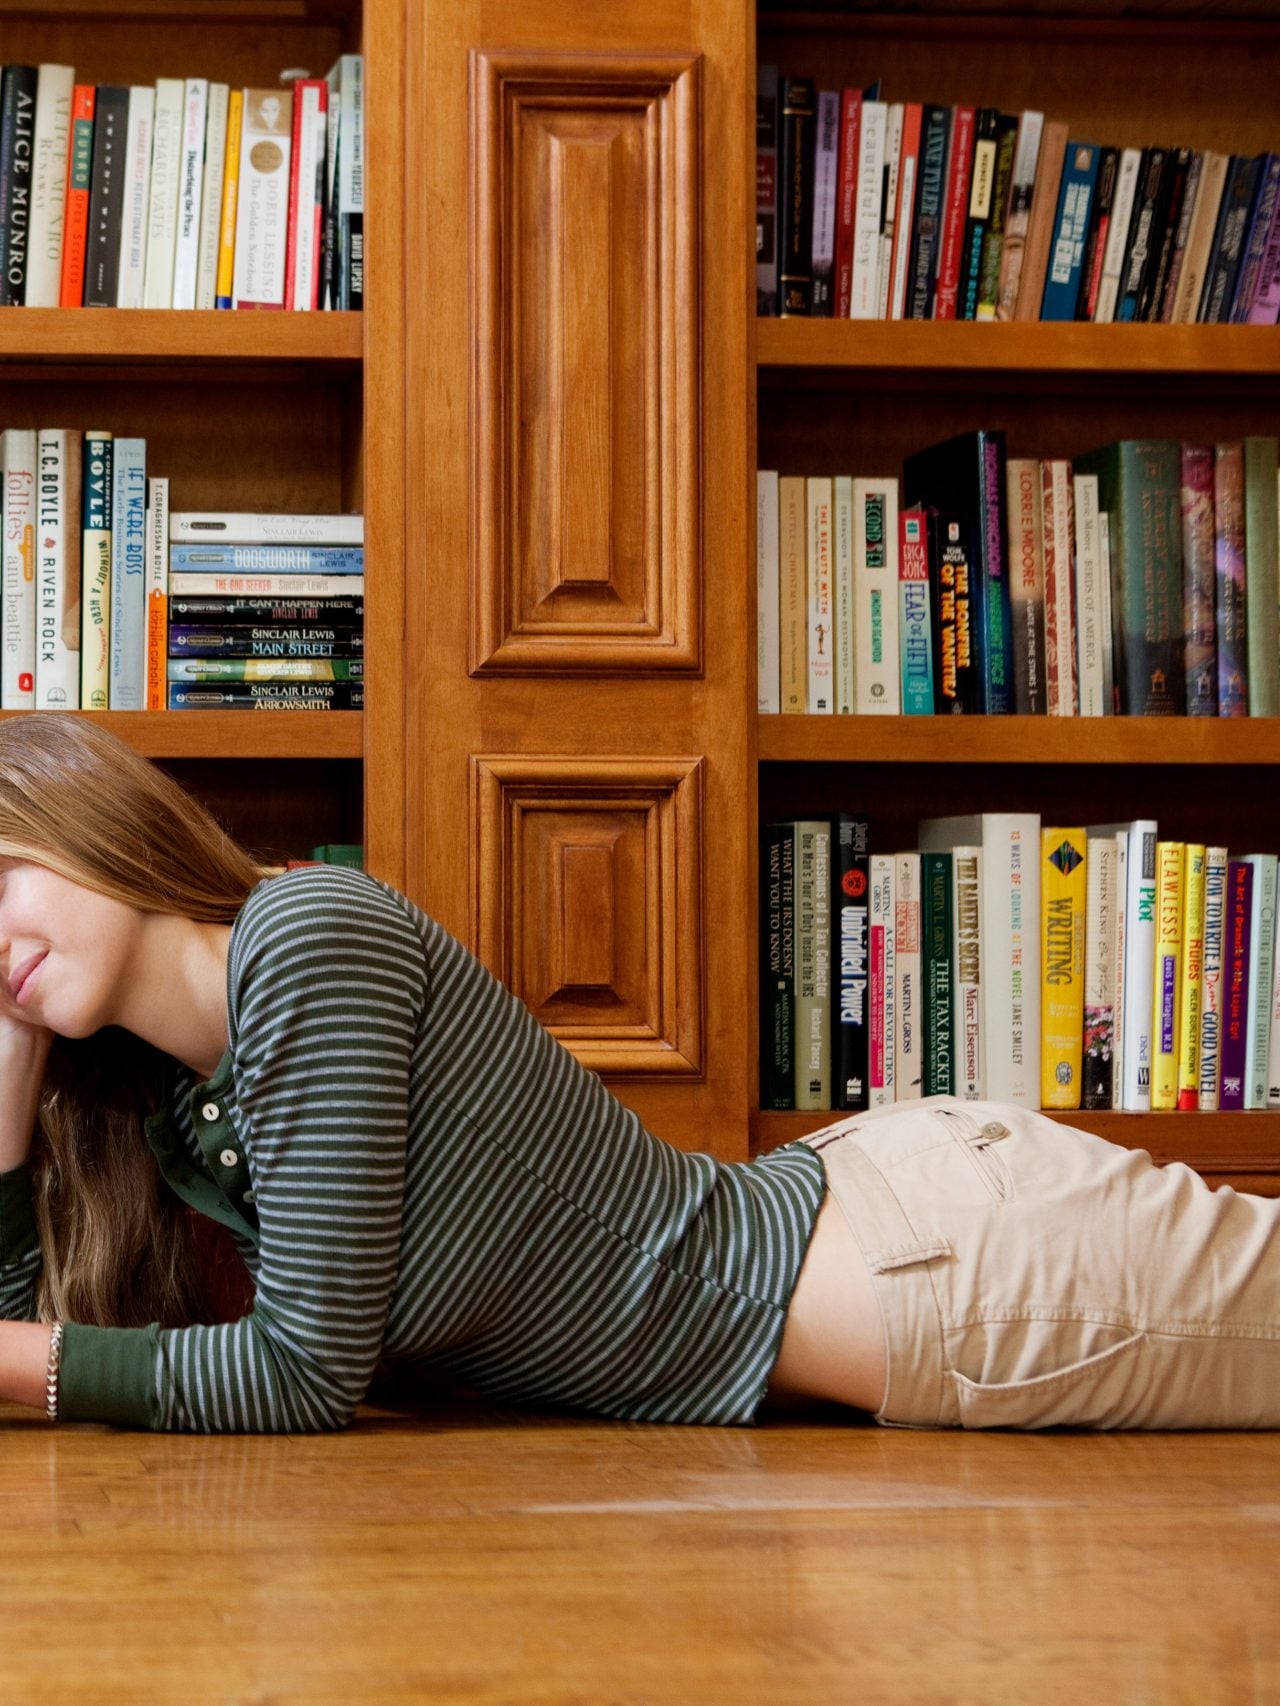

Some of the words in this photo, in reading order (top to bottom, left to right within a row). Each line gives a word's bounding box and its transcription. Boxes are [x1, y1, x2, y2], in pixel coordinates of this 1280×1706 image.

[14, 91, 32, 173] ALICE
[53, 95, 68, 164] ALICE
[35, 139, 53, 209] RUNAWAY
[76, 128, 89, 182] MUNRO
[862, 114, 882, 218] beautiful
[265, 179, 278, 226] DORIS
[351, 165, 361, 205] YOURSELF
[8, 186, 28, 285] MUNRO
[47, 179, 65, 261] MUNRO
[351, 233, 362, 258] DAVID
[858, 229, 878, 267] boy
[263, 233, 276, 299] LESSING
[351, 263, 362, 293] LIPSKY
[90, 442, 103, 528] BOYLE
[128, 467, 143, 482] IF
[7, 470, 33, 540] follies
[127, 498, 142, 537] WERE
[1020, 471, 1032, 526] LORRIE
[866, 495, 881, 542] SECOND
[126, 544, 142, 575] BOSS
[235, 550, 310, 568] DODSWORTH
[867, 545, 882, 567] SEX
[903, 543, 924, 557] ERICA
[1021, 529, 1034, 587] MOORE
[7, 555, 20, 589] ann
[42, 558, 55, 608] RIVEN
[903, 562, 924, 578] JONG
[941, 564, 953, 586] OF
[956, 564, 968, 594] THE
[1084, 560, 1094, 593] BIRDS
[6, 593, 23, 652] beattie
[905, 584, 925, 622] FEAR
[942, 591, 953, 622] THE
[1085, 597, 1094, 613] OF
[42, 618, 55, 661] ROCK
[150, 610, 163, 647] tortilla
[252, 629, 299, 640] SINCLAIR
[303, 629, 335, 639] LEWIS
[911, 625, 921, 635] OF
[957, 600, 969, 667] BONFIRE
[1085, 617, 1095, 669] AMERICA
[150, 650, 161, 688] curtain
[253, 643, 283, 653] MAIN
[289, 644, 334, 656] STREET
[907, 638, 928, 678] FIFTY
[942, 624, 956, 698] VANITIES
[251, 687, 297, 697] SINCLAIR
[301, 687, 334, 696] LEWIS
[254, 699, 330, 710] ARROWSMITH
[958, 857, 977, 879] THE
[958, 883, 979, 939] BANKER'S
[1138, 887, 1155, 922] Plot
[1163, 850, 1179, 944] FLAWLESS!
[841, 906, 866, 975] Unbridled
[1047, 897, 1073, 984] WRITING
[937, 959, 949, 995] THE
[959, 942, 979, 985] SECRET
[841, 980, 864, 1025] Power
[937, 1000, 949, 1026] TAX
[966, 988, 977, 1020] Marc
[812, 1008, 822, 1039] Richard
[809, 1042, 822, 1069] Yancey
[937, 1030, 949, 1094] RACKET
[967, 1023, 978, 1080] Eisenson
